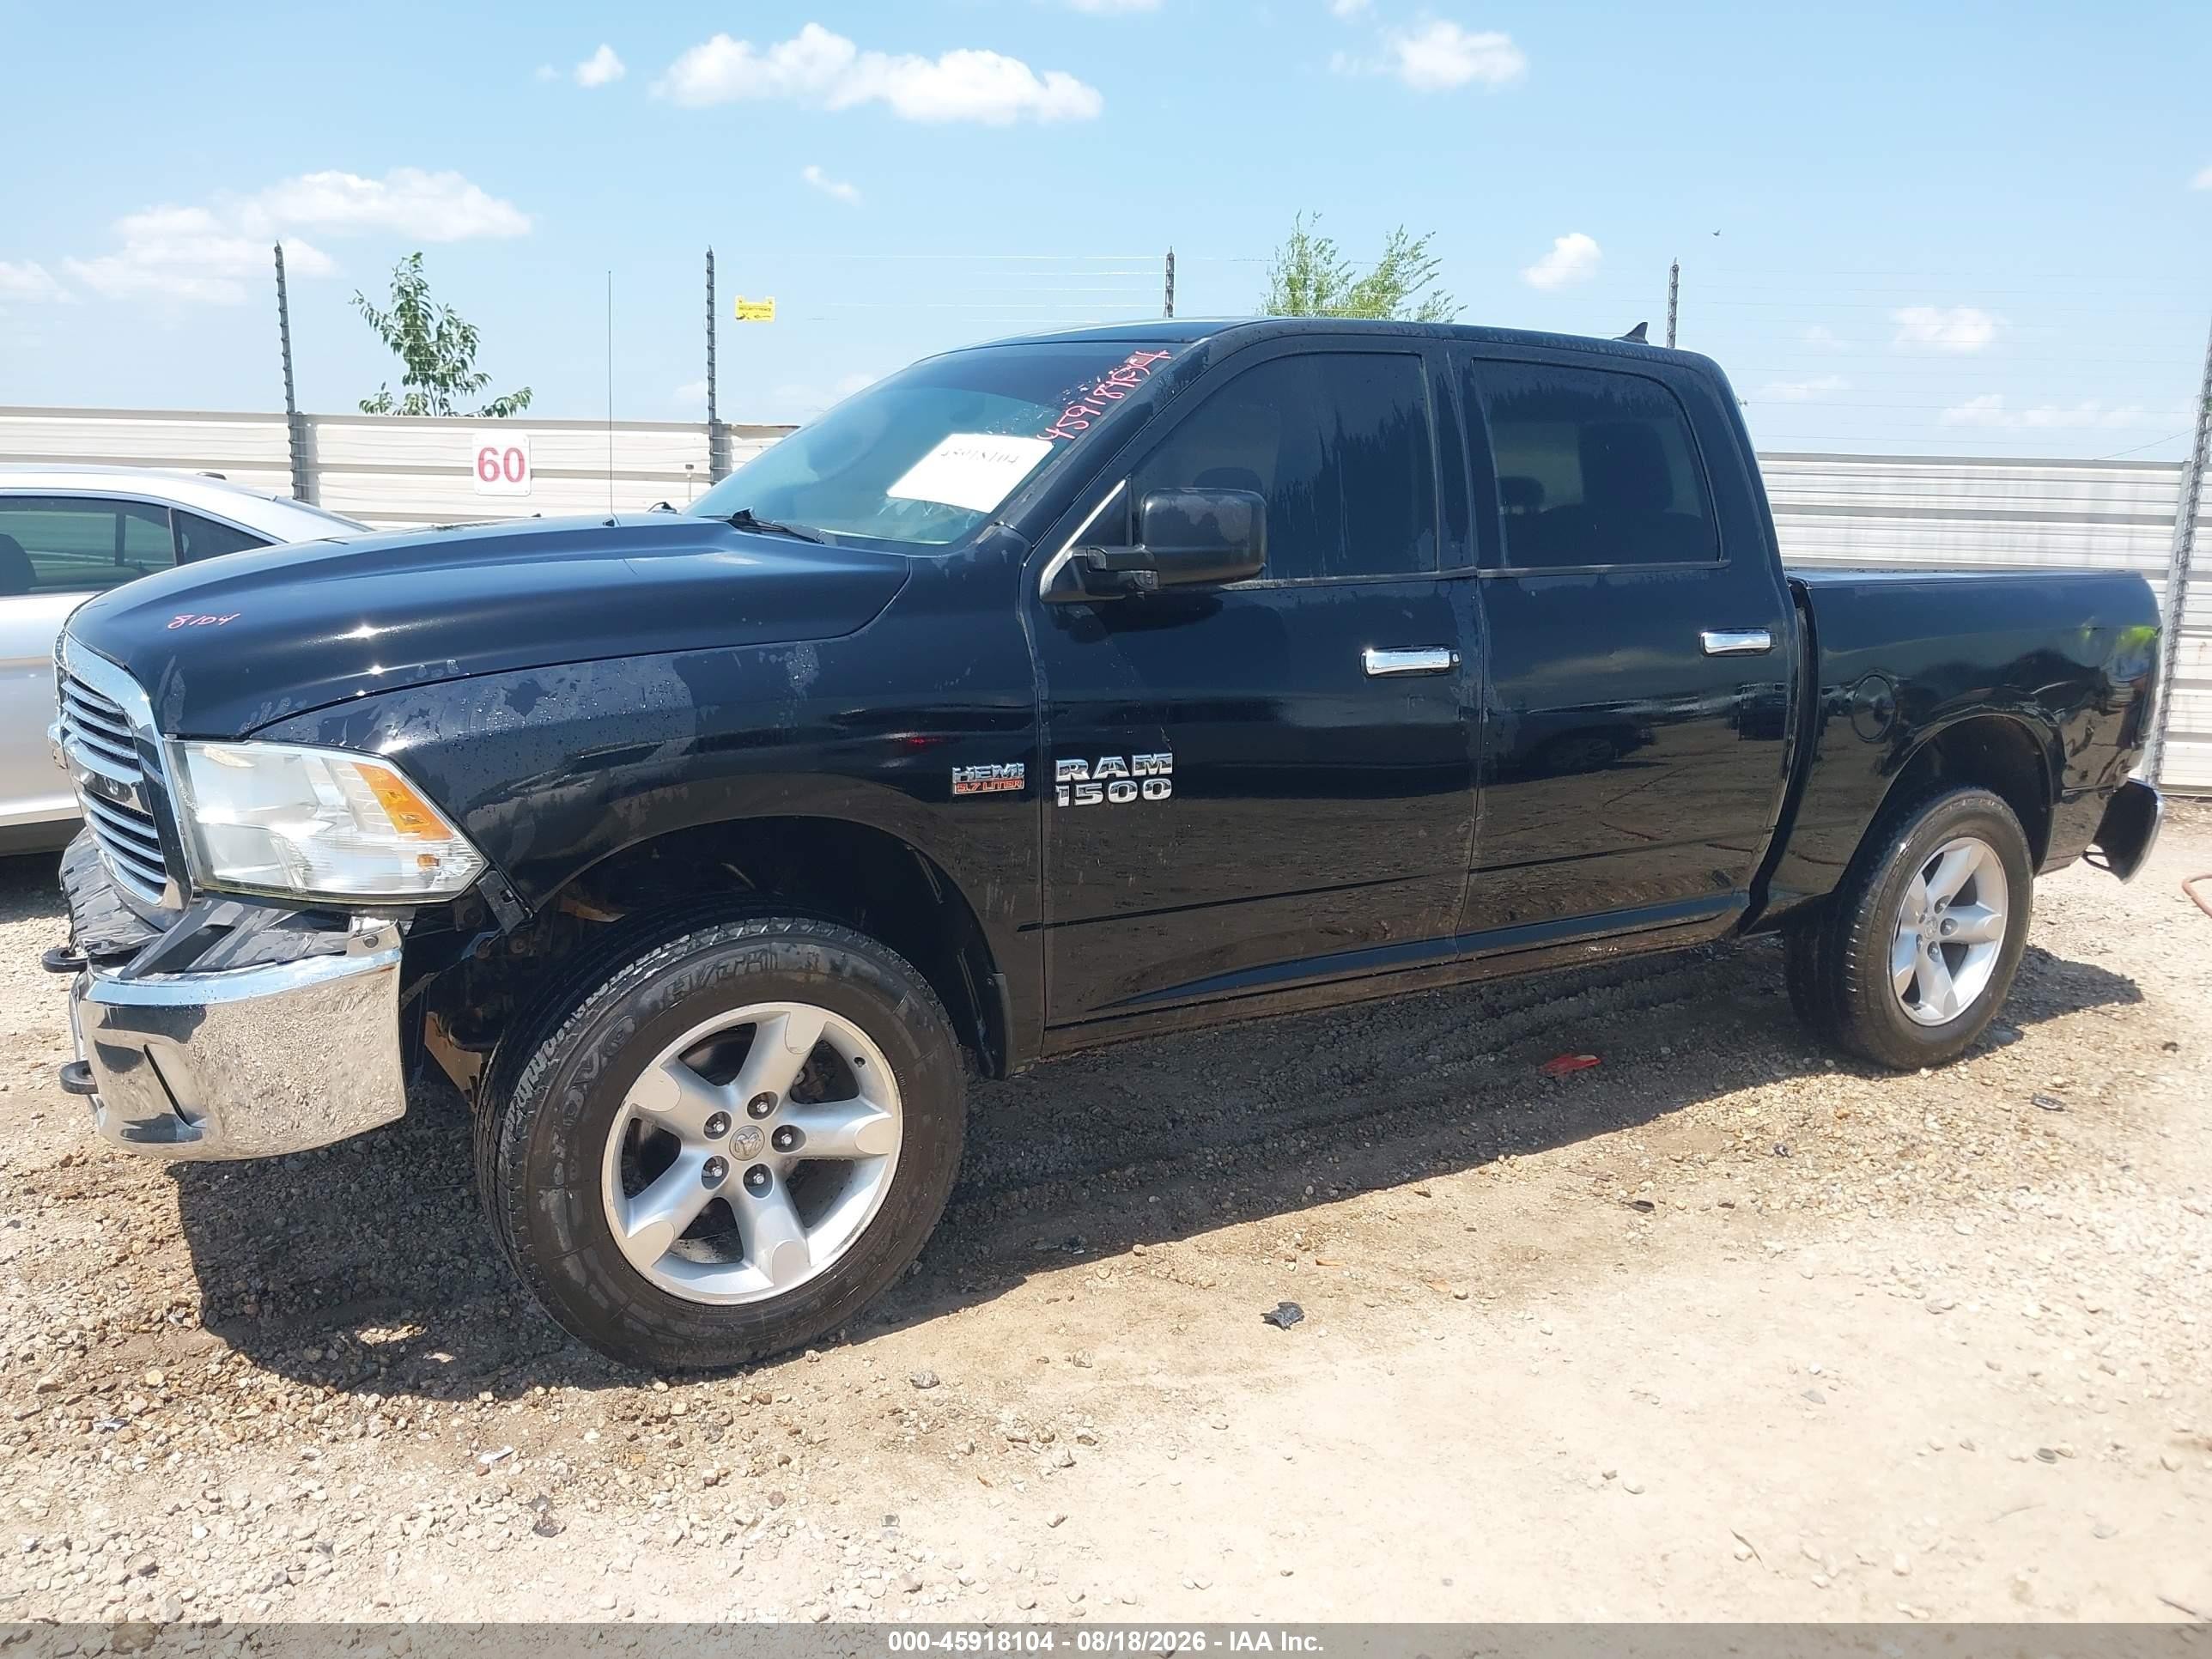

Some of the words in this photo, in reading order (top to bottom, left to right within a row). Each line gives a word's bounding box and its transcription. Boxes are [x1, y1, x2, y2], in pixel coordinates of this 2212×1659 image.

[477, 446, 526, 483] 60
[167, 612, 241, 630] 8104
[951, 763, 1025, 783] HEMI
[1055, 752, 1173, 781] RAM
[957, 782, 981, 793] 5.7
[982, 779, 1023, 791] LITER
[1055, 778, 1173, 807] 1500
